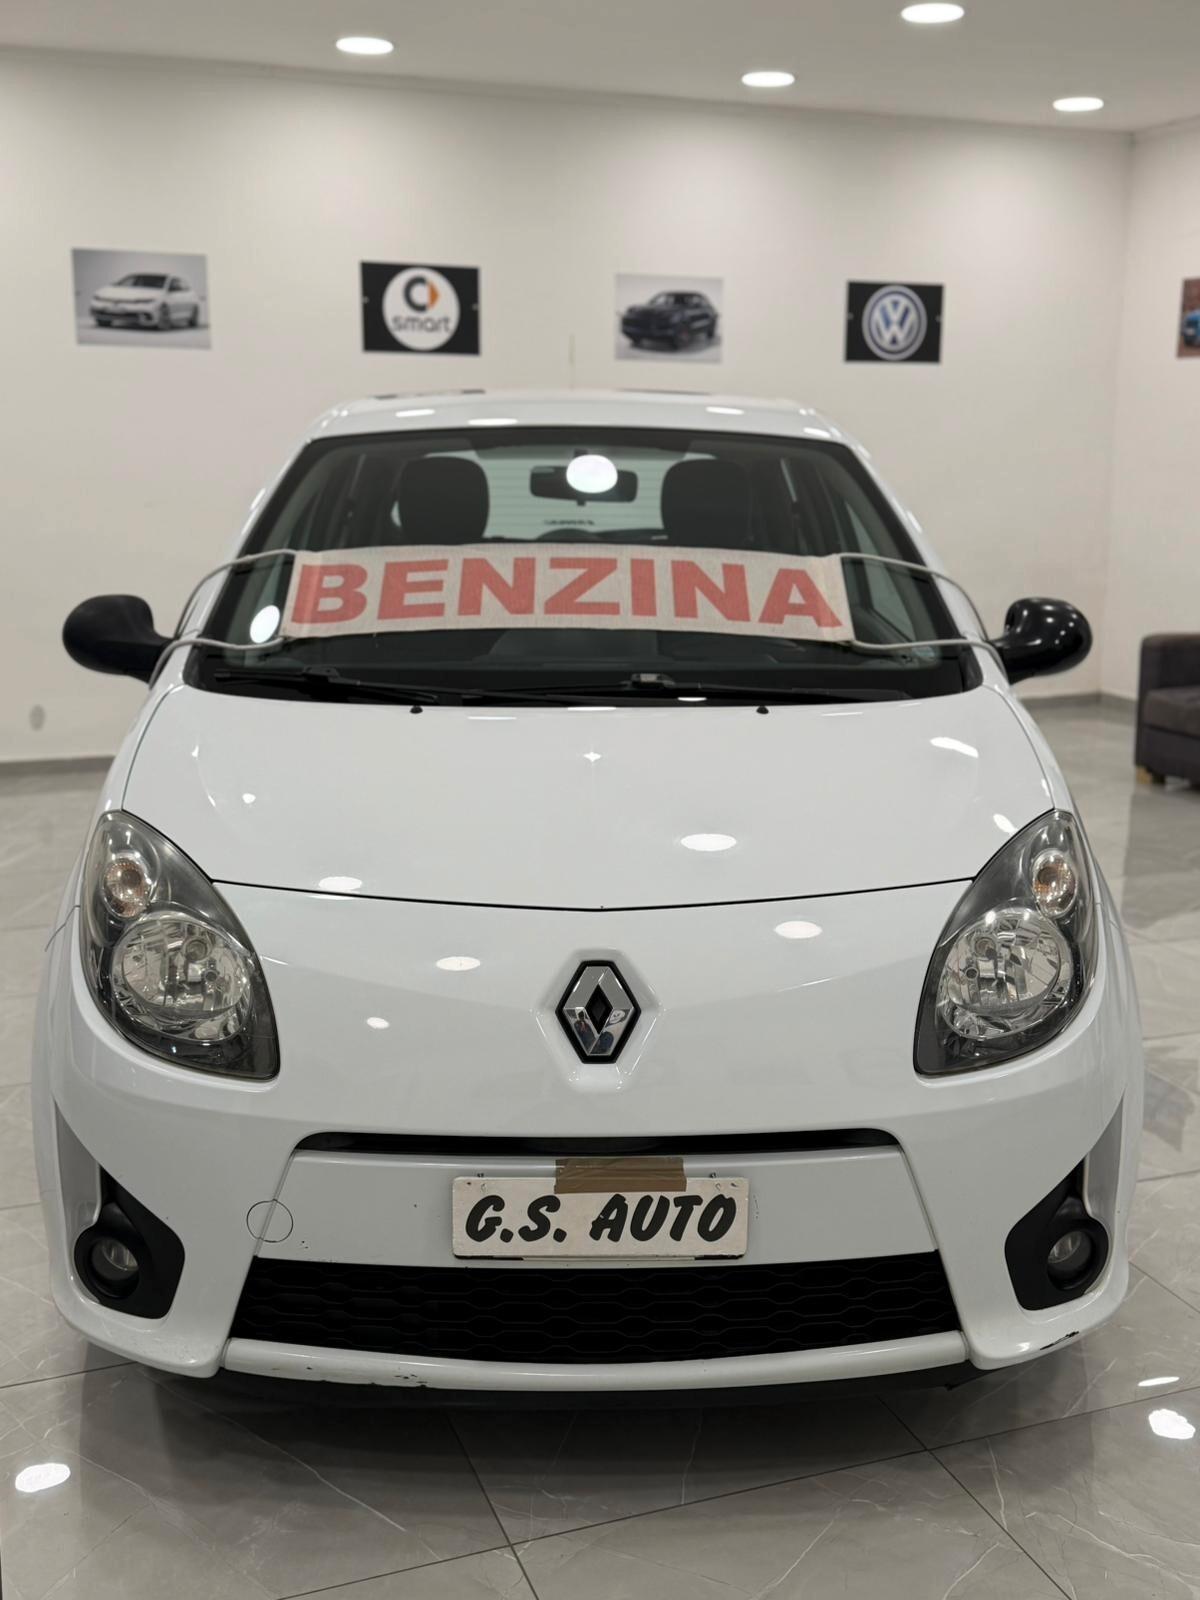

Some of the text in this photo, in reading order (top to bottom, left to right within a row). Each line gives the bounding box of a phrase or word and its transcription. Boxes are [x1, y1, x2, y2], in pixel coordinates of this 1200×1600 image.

[392, 315, 451, 333] smart
[291, 556, 843, 628] BENZINA
[465, 1193, 737, 1243] G.S. AUTO
